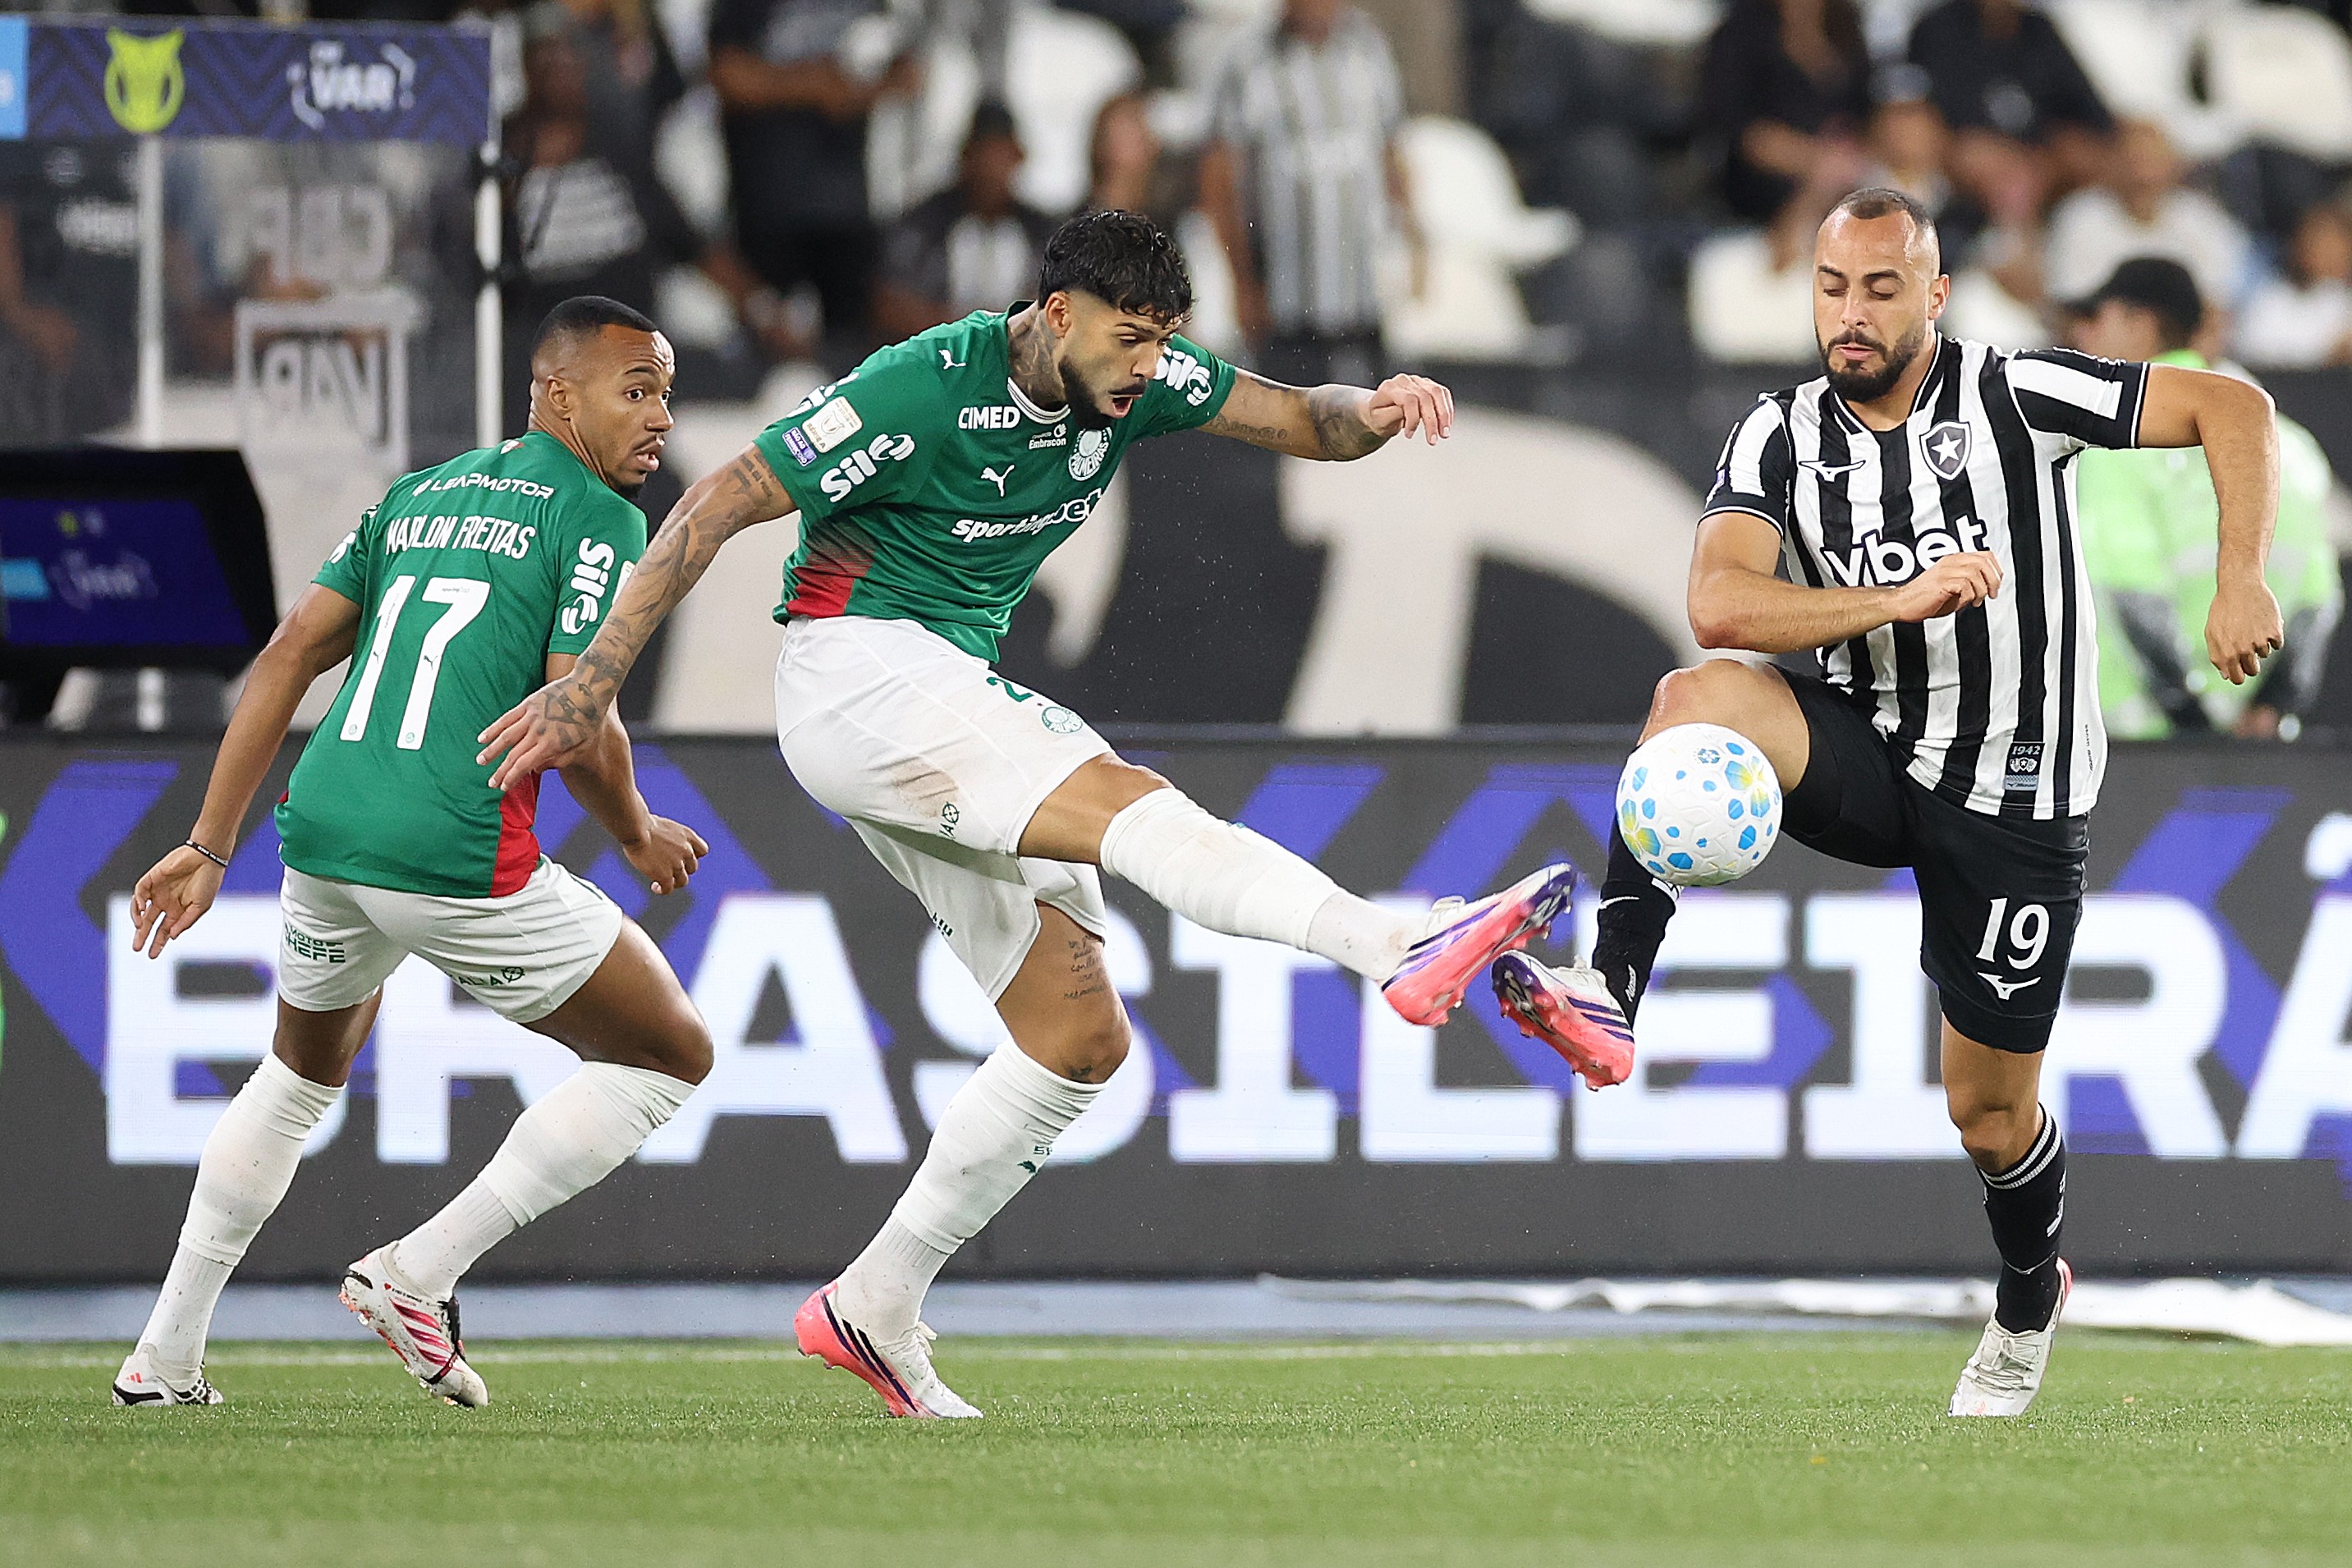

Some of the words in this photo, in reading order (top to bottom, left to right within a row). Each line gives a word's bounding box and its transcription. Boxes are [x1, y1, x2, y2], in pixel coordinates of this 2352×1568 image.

[310, 63, 395, 110] VAR
[958, 406, 1020, 429] CIMED
[1029, 438, 1066, 450] Embracon
[1070, 442, 1109, 476] PALMEIRAS
[430, 473, 554, 499] LEAPMOTOR
[452, 516, 536, 560] FREITAS
[1823, 515, 1983, 587] vbet
[340, 575, 491, 750] 17
[2011, 745, 2042, 755] 1942
[1976, 896, 2050, 971] 19
